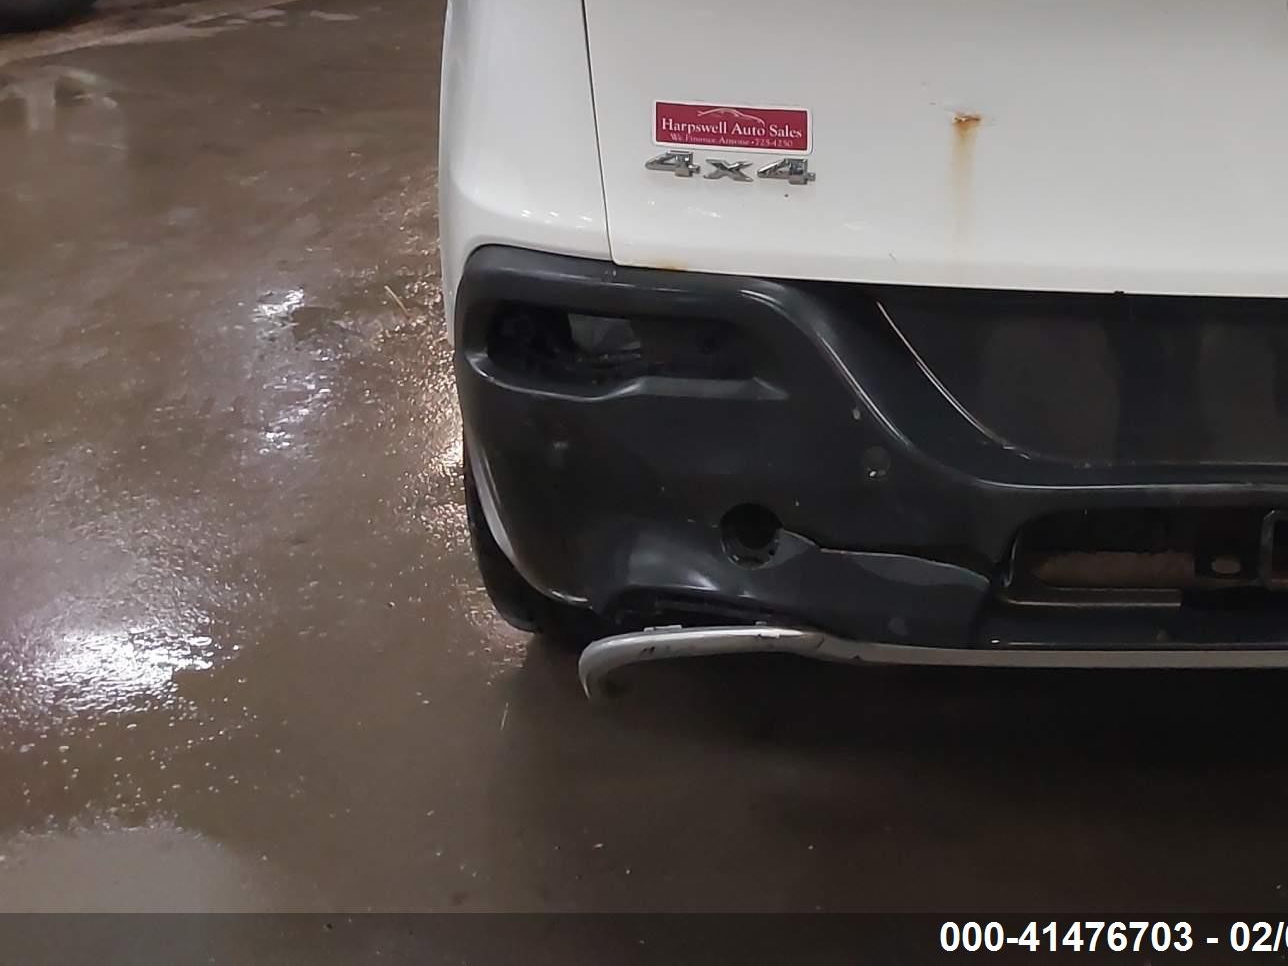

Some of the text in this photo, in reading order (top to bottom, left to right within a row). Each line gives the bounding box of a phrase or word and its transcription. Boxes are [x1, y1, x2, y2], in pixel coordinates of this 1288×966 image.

[662, 117, 802, 138] Harpswell Auto Sales
